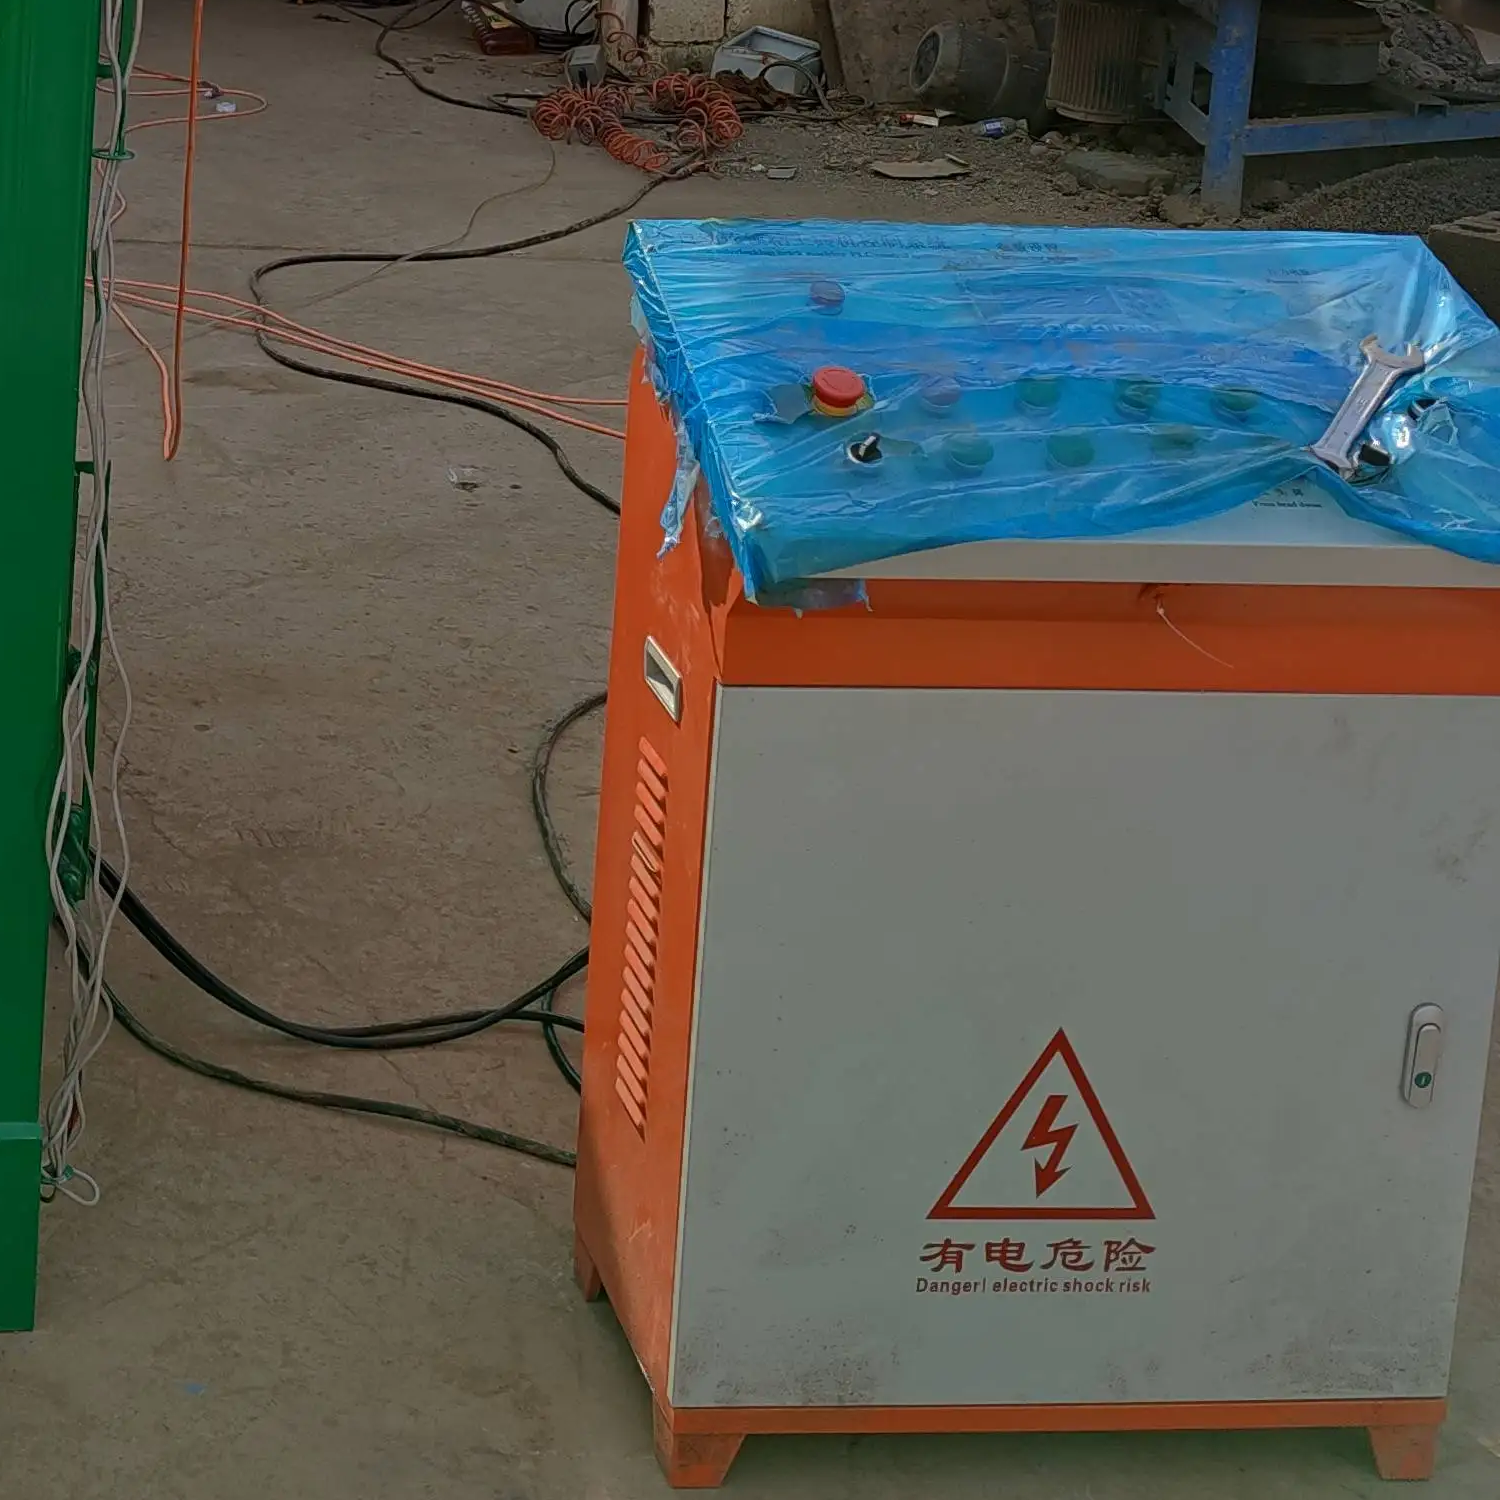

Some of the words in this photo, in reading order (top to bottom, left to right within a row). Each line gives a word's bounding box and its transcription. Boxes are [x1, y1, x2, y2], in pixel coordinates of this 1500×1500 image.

[920, 1237, 1156, 1273] 有电危险
[992, 1277, 1058, 1293] electric
[1063, 1277, 1114, 1293] shock
[1119, 1277, 1151, 1293] risk
